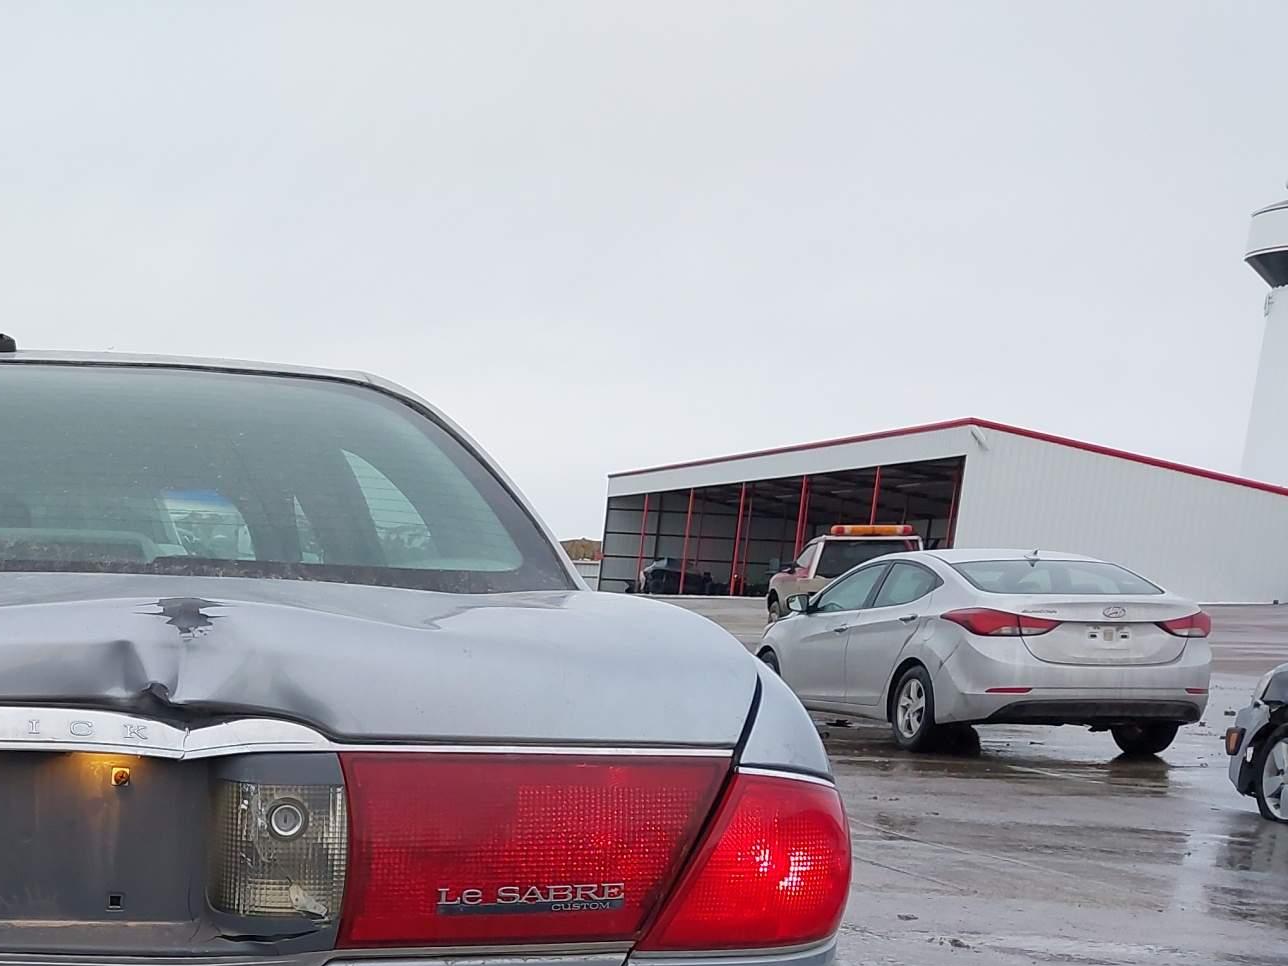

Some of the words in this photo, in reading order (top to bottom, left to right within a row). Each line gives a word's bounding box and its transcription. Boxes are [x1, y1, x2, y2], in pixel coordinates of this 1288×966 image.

[437, 887, 483, 905] Le
[496, 882, 625, 905] SABRE
[551, 901, 610, 912] CUSTOM
